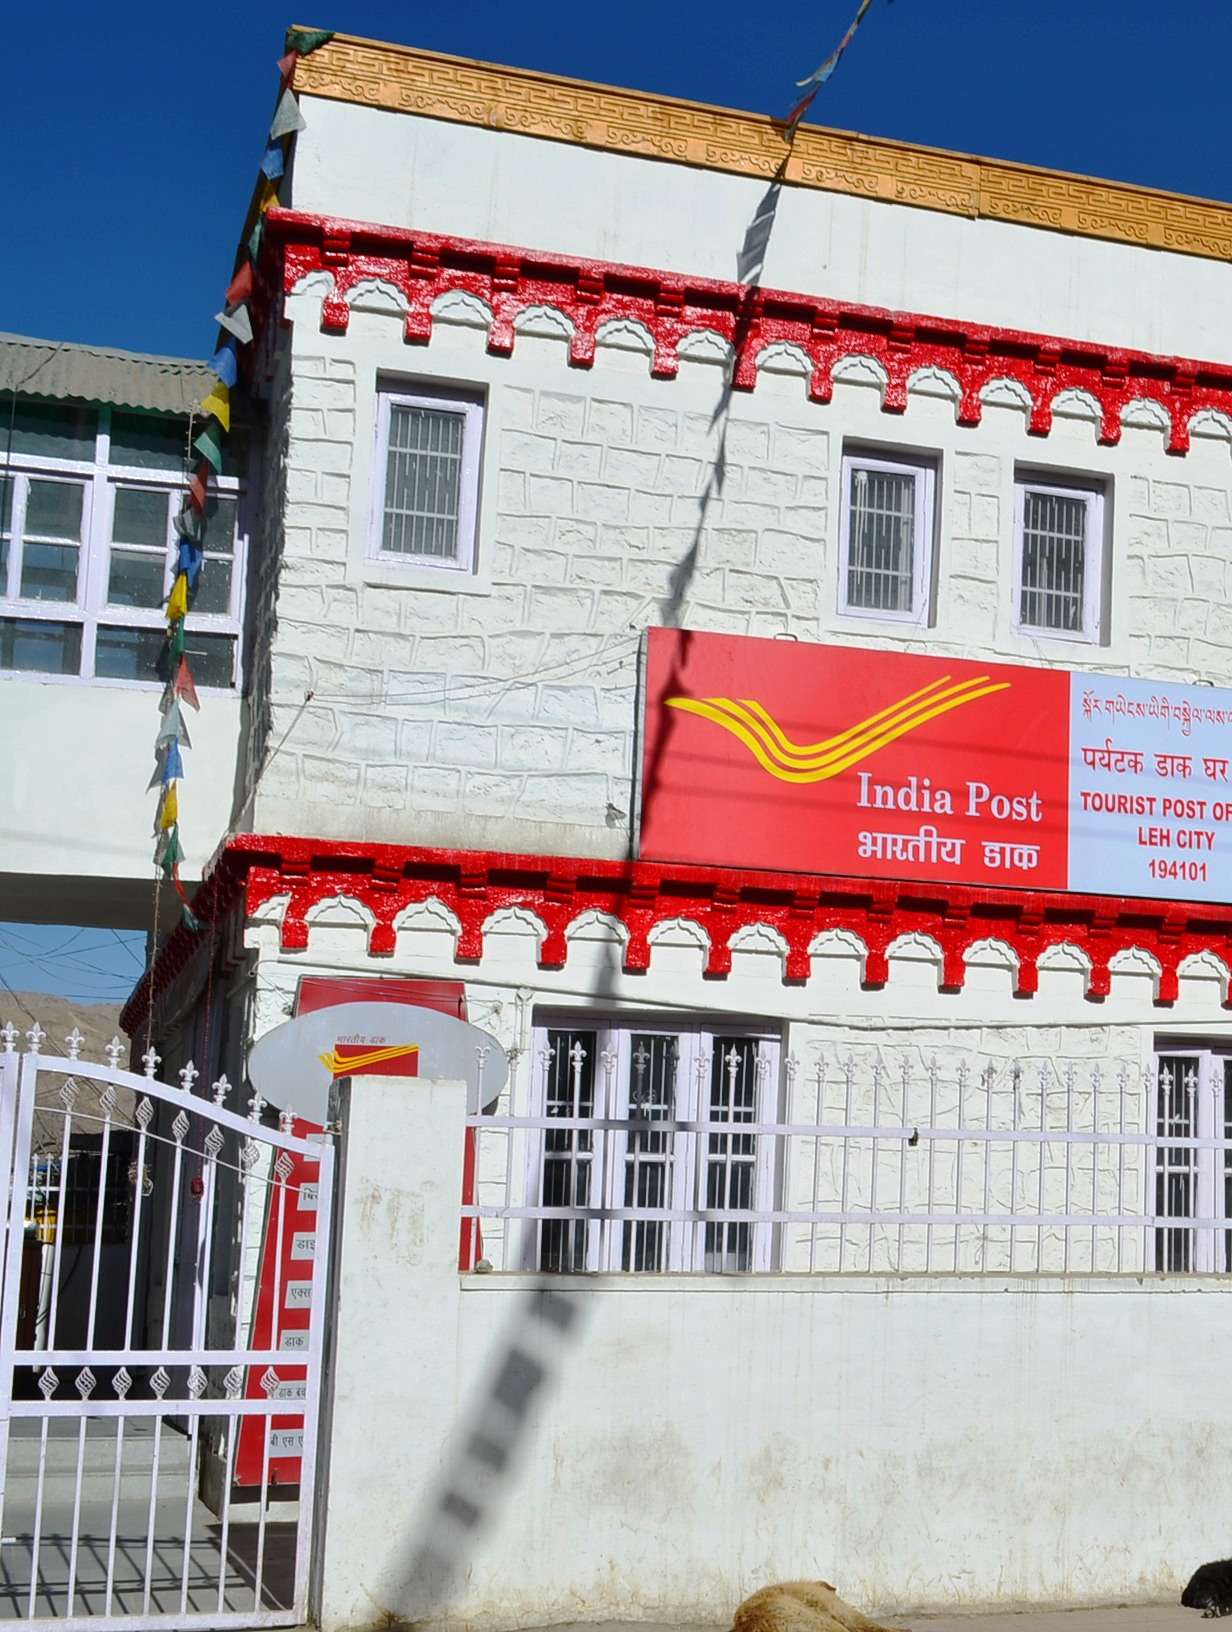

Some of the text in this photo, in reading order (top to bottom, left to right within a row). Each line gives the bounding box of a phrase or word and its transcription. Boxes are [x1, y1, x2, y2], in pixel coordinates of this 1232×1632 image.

[1081, 738, 1144, 775] पर्यटक
[1153, 753, 1192, 779] डाक
[1203, 758, 1229, 783] घर
[856, 771, 1042, 822] India Post
[1080, 791, 1157, 816] TOURIST
[1162, 798, 1207, 820] POST
[857, 825, 1041, 870] भारतीय डाक
[1138, 826, 1216, 850] LEH CITY
[1148, 859, 1207, 882] 194101
[285, 1336, 304, 1348] डाक
[282, 1437, 294, 1448] एस
